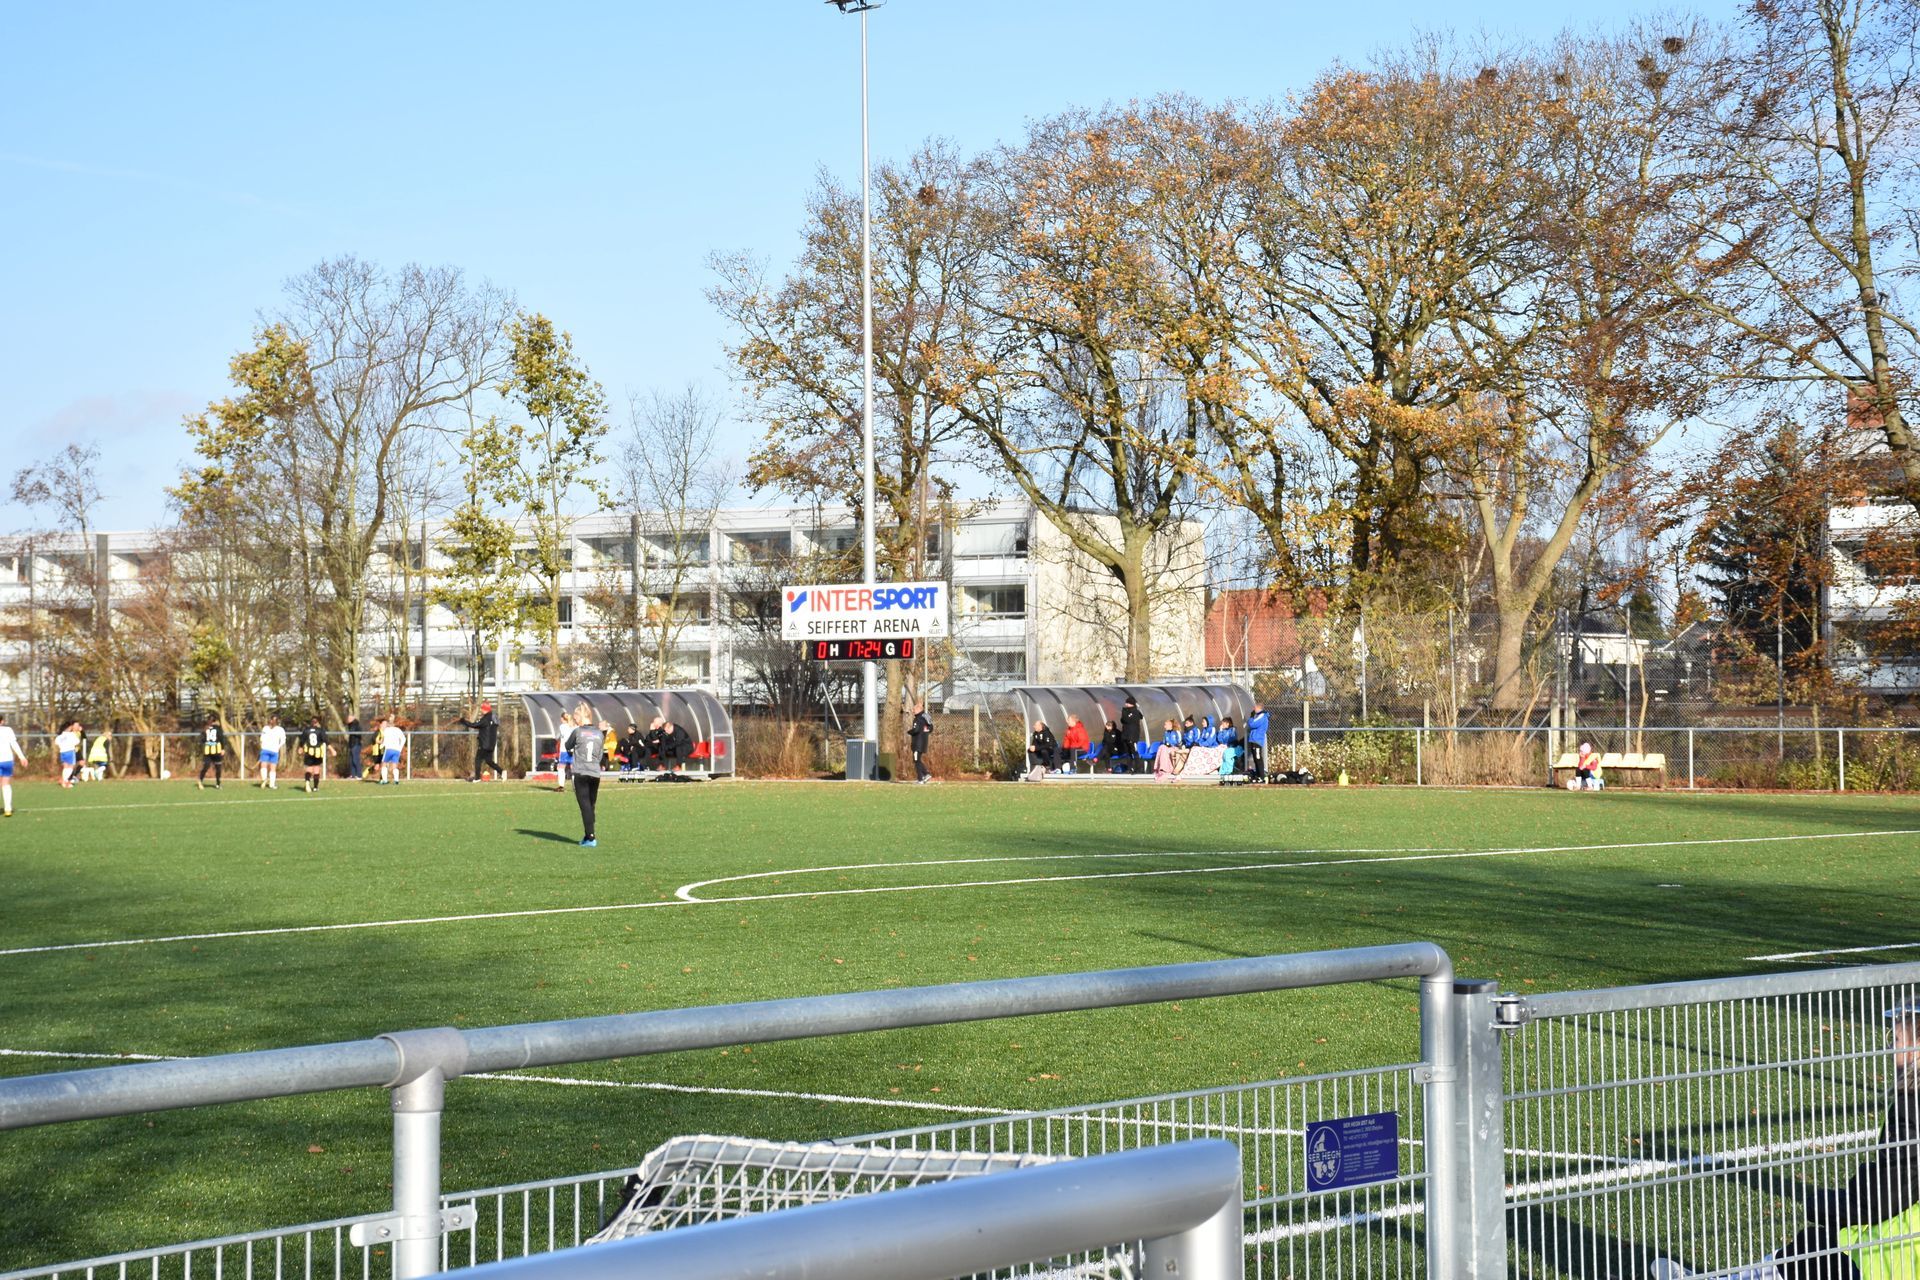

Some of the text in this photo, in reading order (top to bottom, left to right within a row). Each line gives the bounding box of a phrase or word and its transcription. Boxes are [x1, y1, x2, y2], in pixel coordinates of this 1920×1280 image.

[811, 587, 938, 612] INTERSPORT
[808, 618, 920, 635] SEIFFERT ARENA
[817, 640, 911, 659] 0 H 17:24 G 0
[586, 741, 594, 762] 1
[1308, 1150, 1341, 1163] SER HEGN
